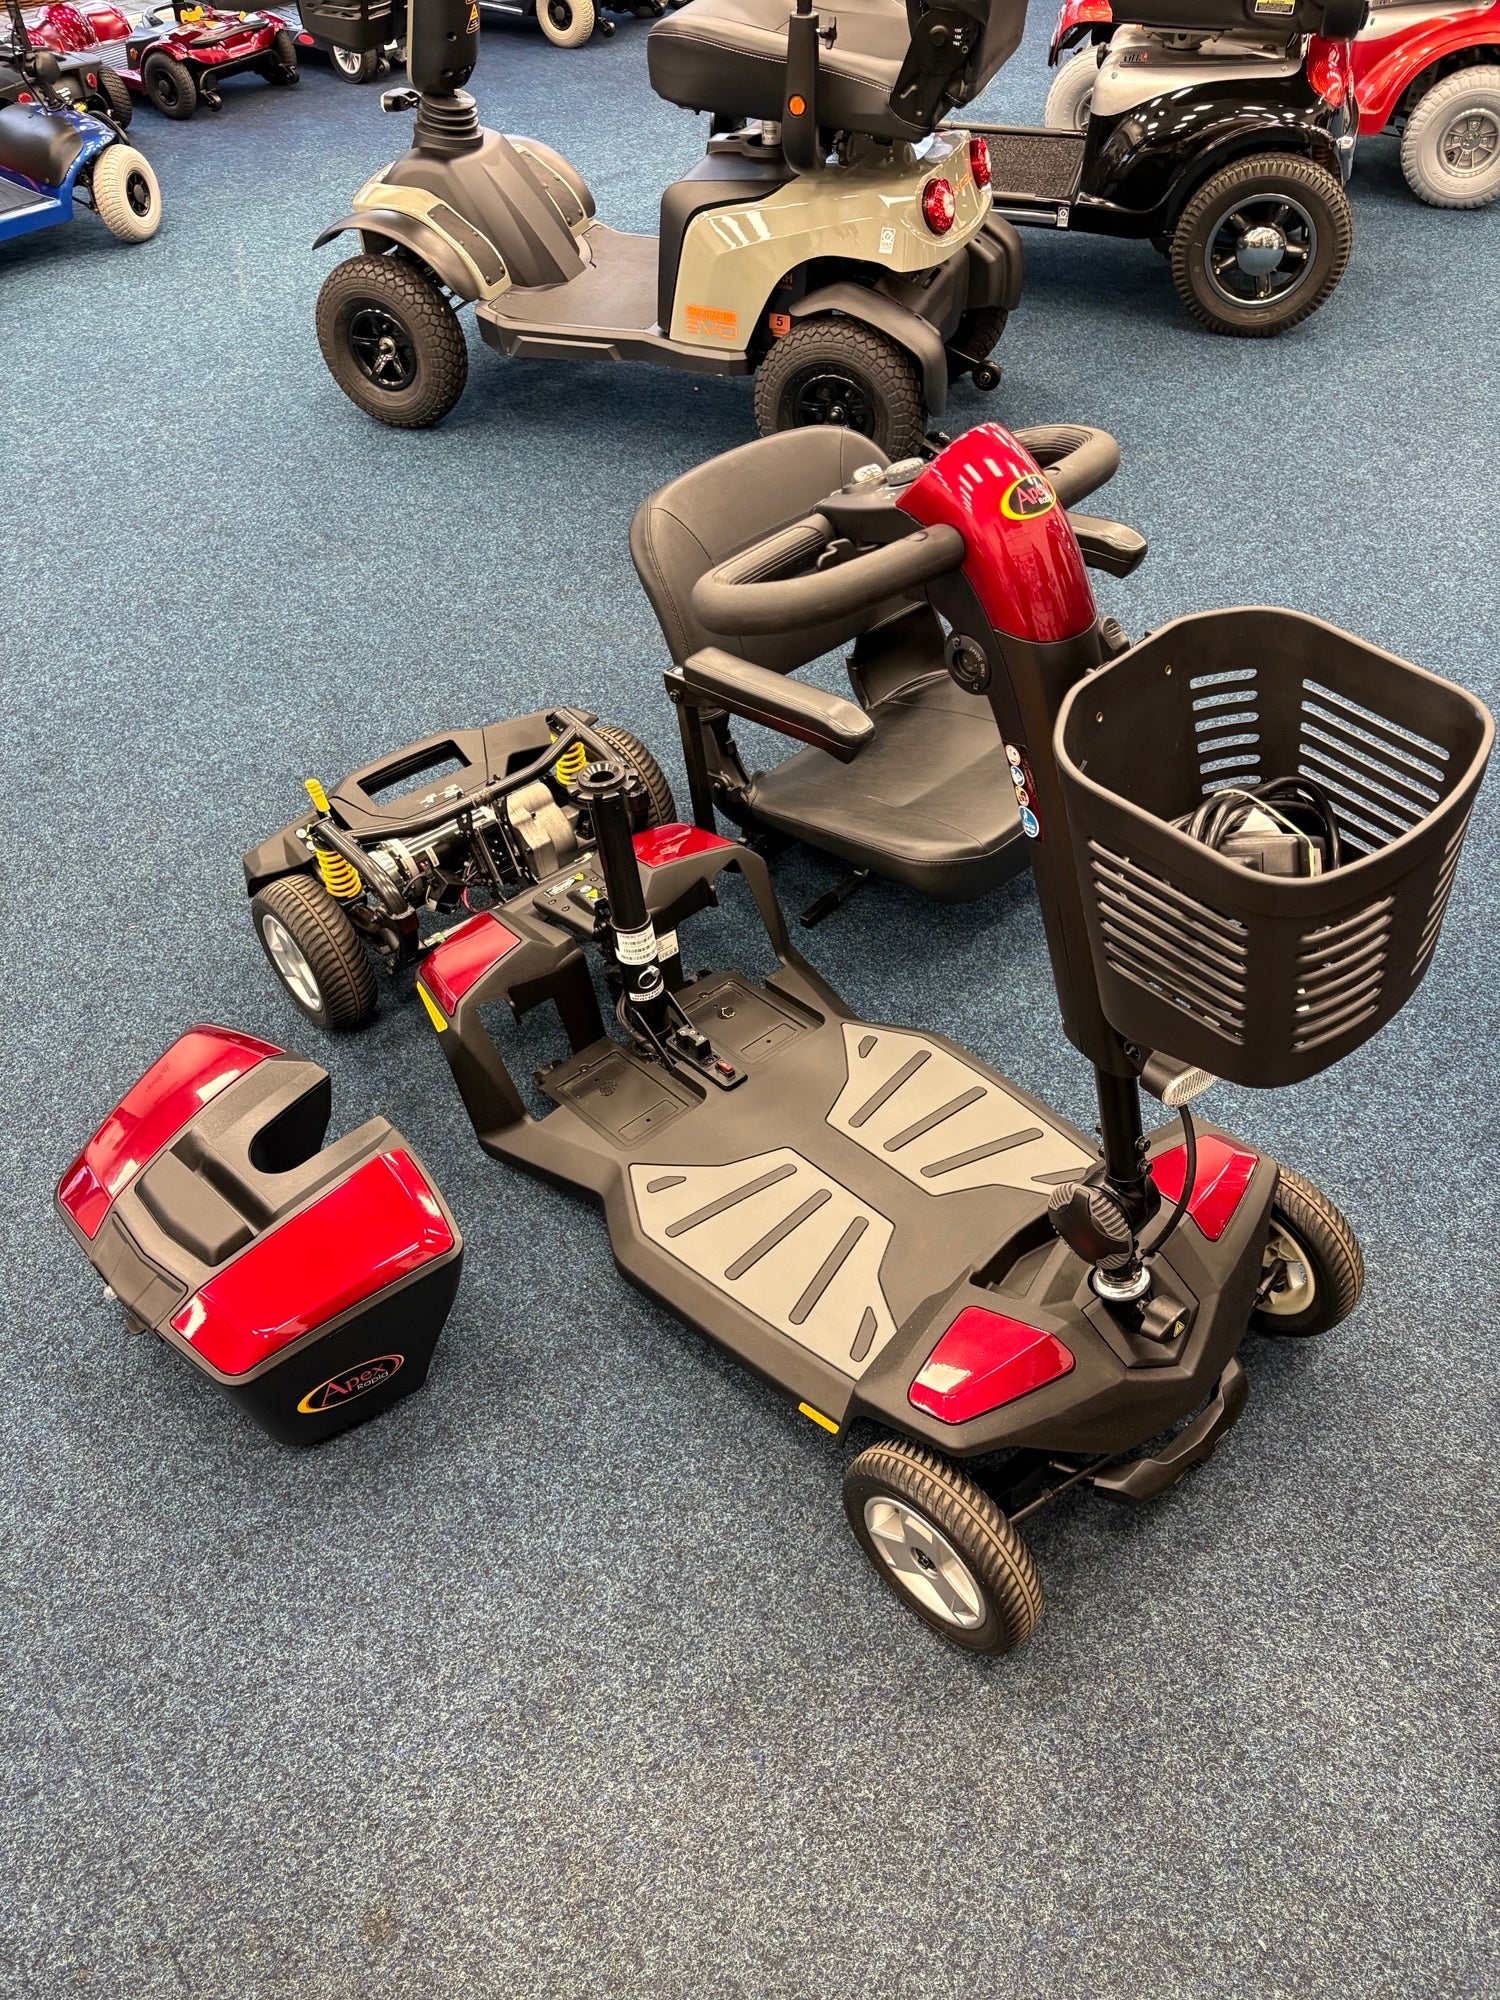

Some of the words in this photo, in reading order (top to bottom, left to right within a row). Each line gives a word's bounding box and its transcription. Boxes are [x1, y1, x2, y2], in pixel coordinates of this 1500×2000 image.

[686, 318, 738, 340] EVO
[776, 316, 784, 327] 5
[322, 1364, 386, 1407] Apex
[357, 1371, 389, 1391] Rapid
